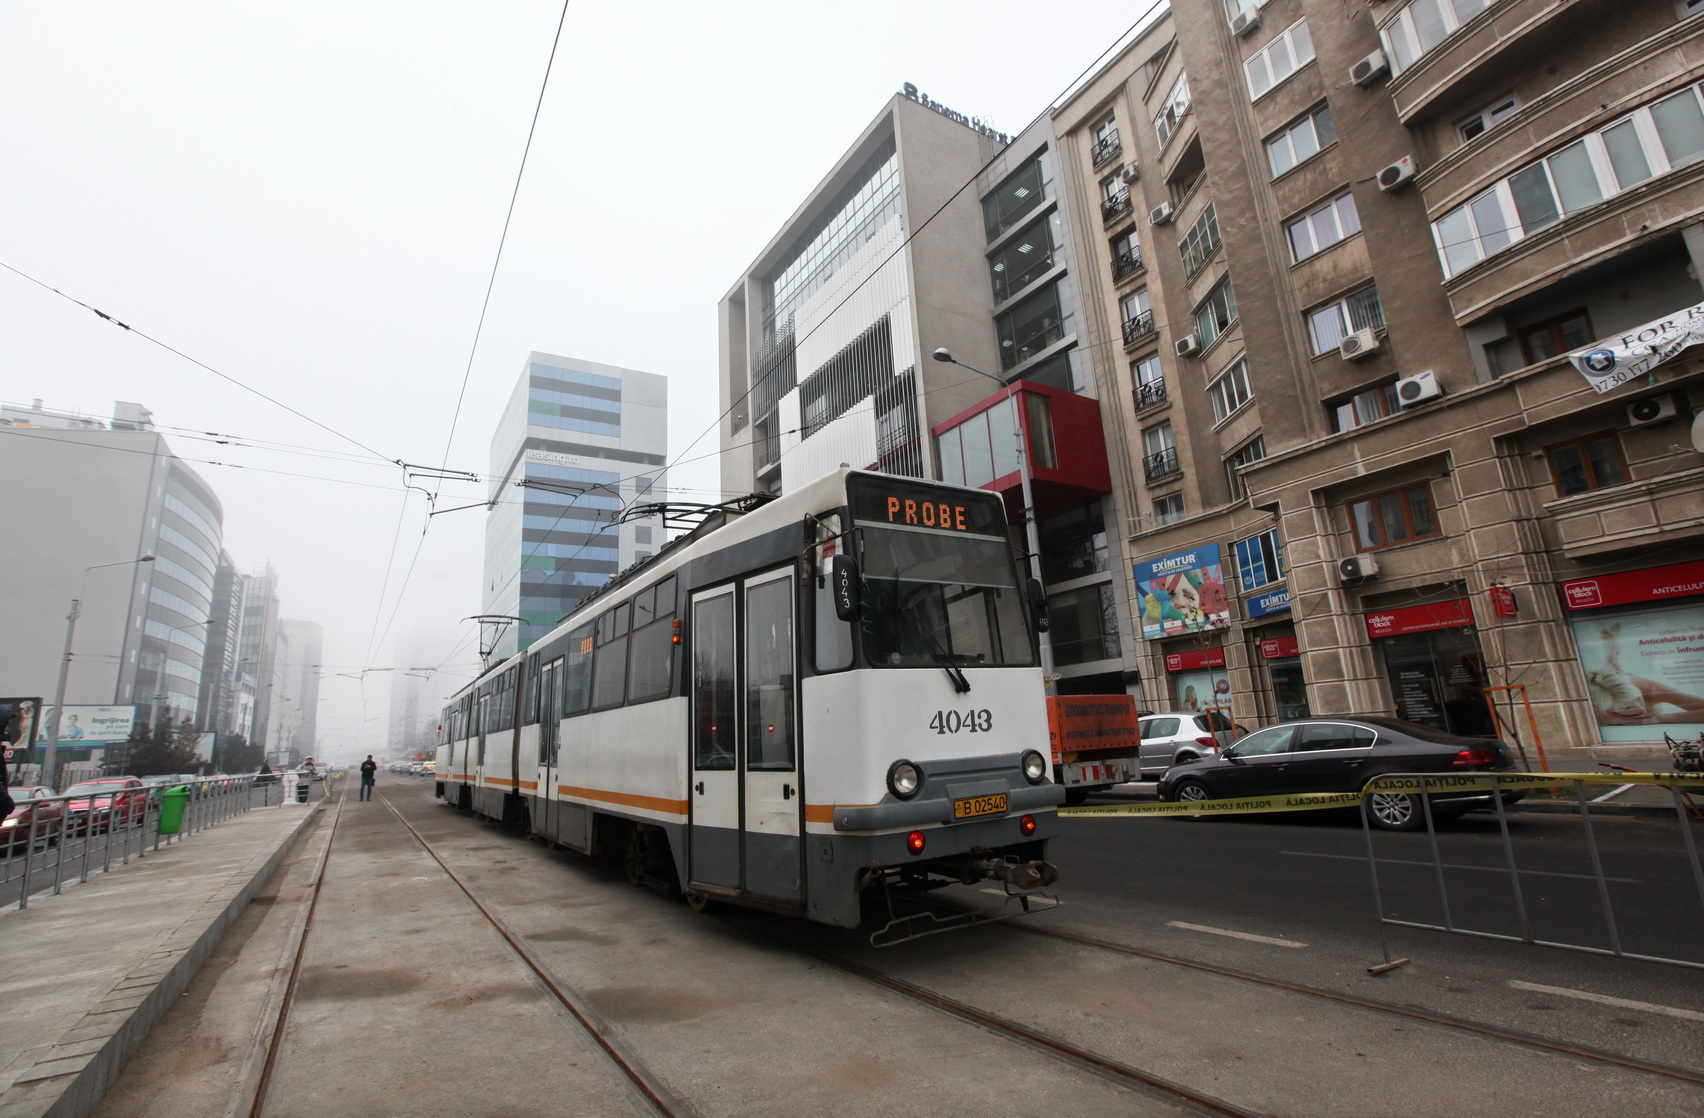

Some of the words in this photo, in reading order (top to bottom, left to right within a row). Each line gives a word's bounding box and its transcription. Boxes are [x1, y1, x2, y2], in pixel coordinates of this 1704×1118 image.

[1621, 321, 1676, 349] FOR
[1627, 358, 1652, 378] 177
[1656, 342, 1683, 363] 260
[526, 450, 580, 465] leasing.ro
[887, 496, 967, 530] PROBE
[840, 568, 851, 609] 4043
[1368, 615, 1394, 624] cellulem
[929, 708, 993, 735] 4043
[963, 799, 972, 815] B
[974, 794, 1006, 812] 02540
